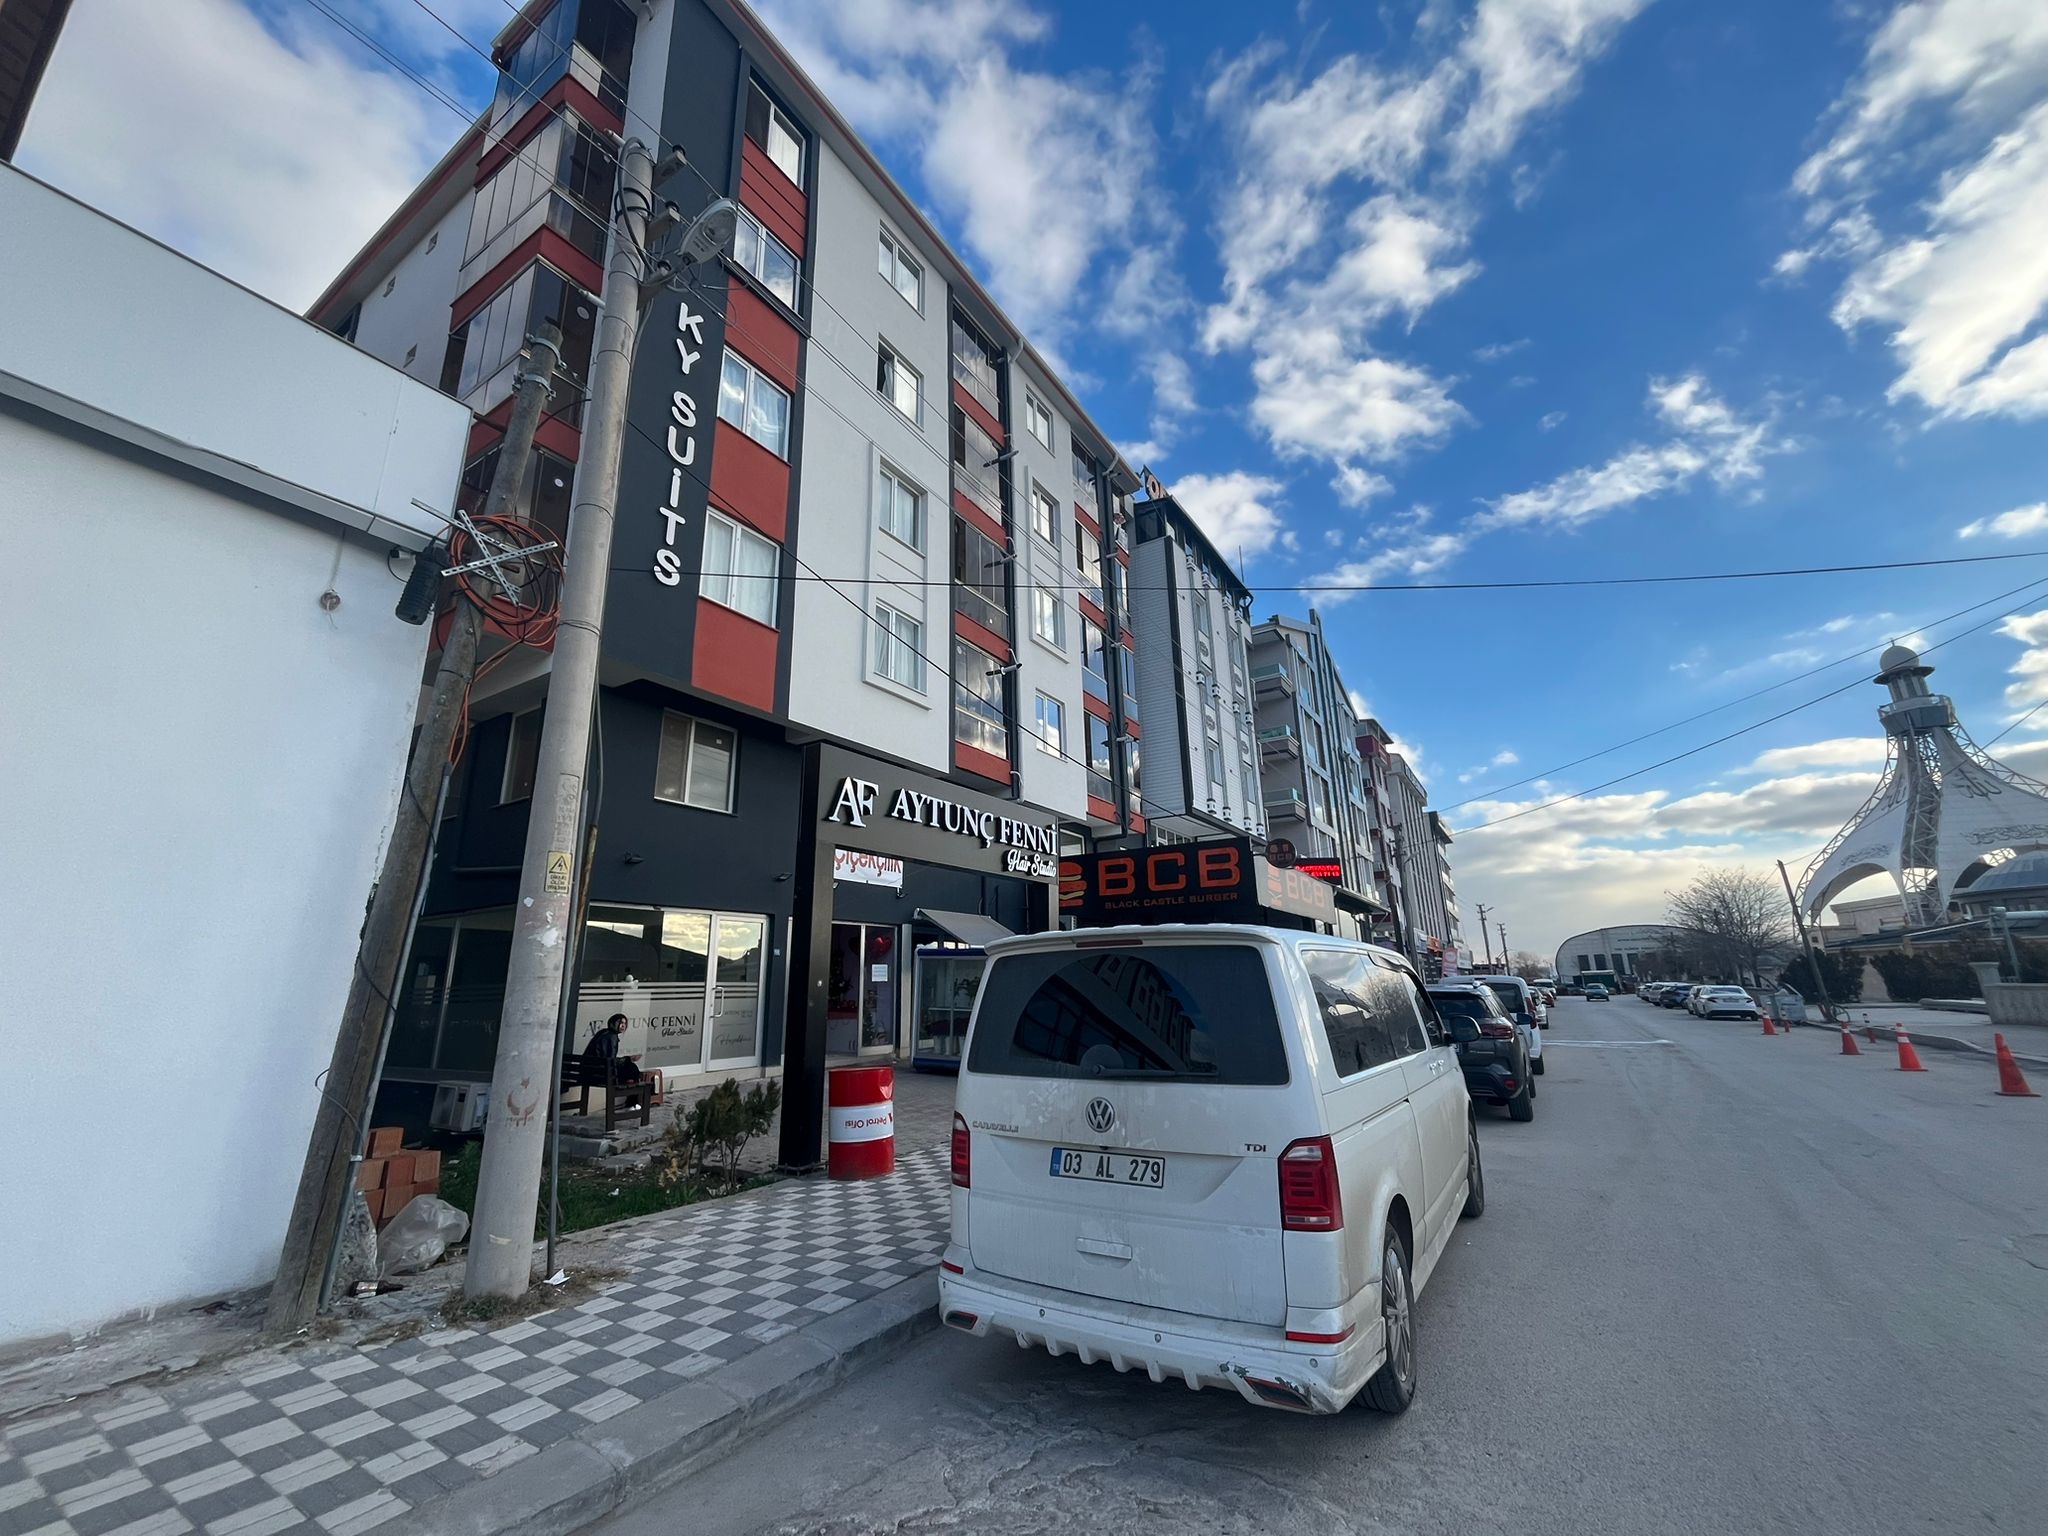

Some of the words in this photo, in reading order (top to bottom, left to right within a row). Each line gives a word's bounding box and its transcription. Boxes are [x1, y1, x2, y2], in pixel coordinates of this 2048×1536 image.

[828, 776, 879, 828] AF
[891, 788, 994, 849] AYTUNÇ
[999, 816, 1058, 856] FENNİ
[1007, 848, 1031, 872] Hair
[1031, 853, 1057, 877] Studio
[1098, 846, 1241, 897] BCB
[1104, 900, 1141, 910] BLACK
[1143, 896, 1185, 907] CASTLE
[1189, 892, 1238, 903] BURGER
[1286, 870, 1325, 908] BCB
[1244, 1143, 1266, 1152] TDI
[1063, 1152, 1081, 1175] 03
[1095, 1155, 1114, 1179] AL
[1128, 1159, 1161, 1184] 279
